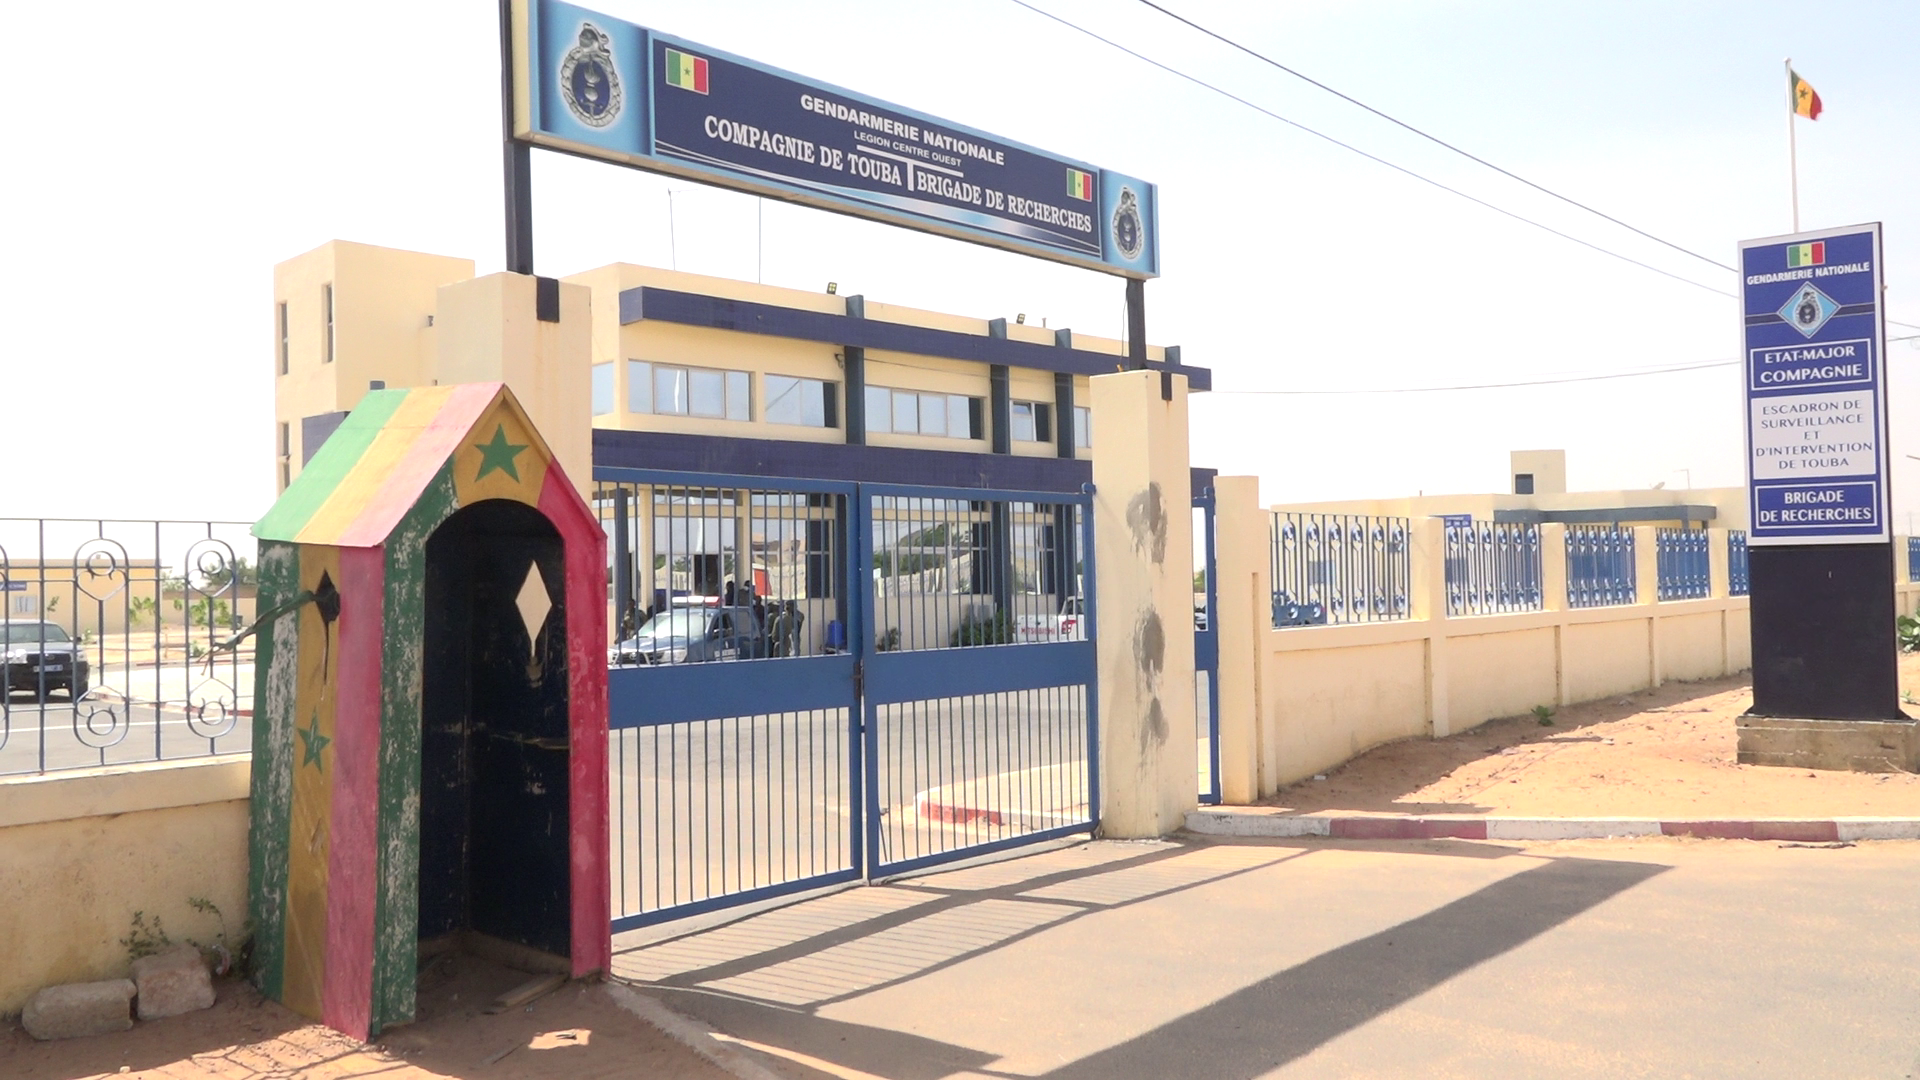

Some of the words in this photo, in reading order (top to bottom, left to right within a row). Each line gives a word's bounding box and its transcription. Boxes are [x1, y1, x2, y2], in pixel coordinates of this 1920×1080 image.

[800, 94, 919, 142] GENDARMERIE
[923, 127, 1005, 166] NATIONALE
[704, 114, 816, 164] COMPAGNIE
[820, 146, 843, 169] DE
[847, 152, 902, 186] TOUBA
[854, 130, 889, 149] LEGION
[892, 139, 930, 158] CENTRE
[931, 149, 962, 167] OUEST
[916, 170, 982, 205] BRIGADE
[985, 189, 1005, 211] DE
[1008, 196, 1092, 233] RECHERCHES
[1747, 269, 1813, 285] GENDARMERIE
[1815, 262, 1870, 277] NATIONALE
[1765, 346, 1855, 363] ETAT-MAJOR
[1760, 364, 1862, 383] COMPAGNIE
[1762, 402, 1839, 415] ESCADRON
[1843, 400, 1862, 410] DE
[1761, 414, 1864, 429] SURVEILLANCE
[1804, 431, 1820, 440] ET
[1756, 442, 1872, 457] D'INTERVENTION
[1779, 460, 1796, 470] DE
[1801, 458, 1849, 468] TOUBA
[1784, 490, 1844, 504] BRIGADE
[1760, 510, 1778, 522] DE
[1781, 507, 1872, 522] RECHERCHES
